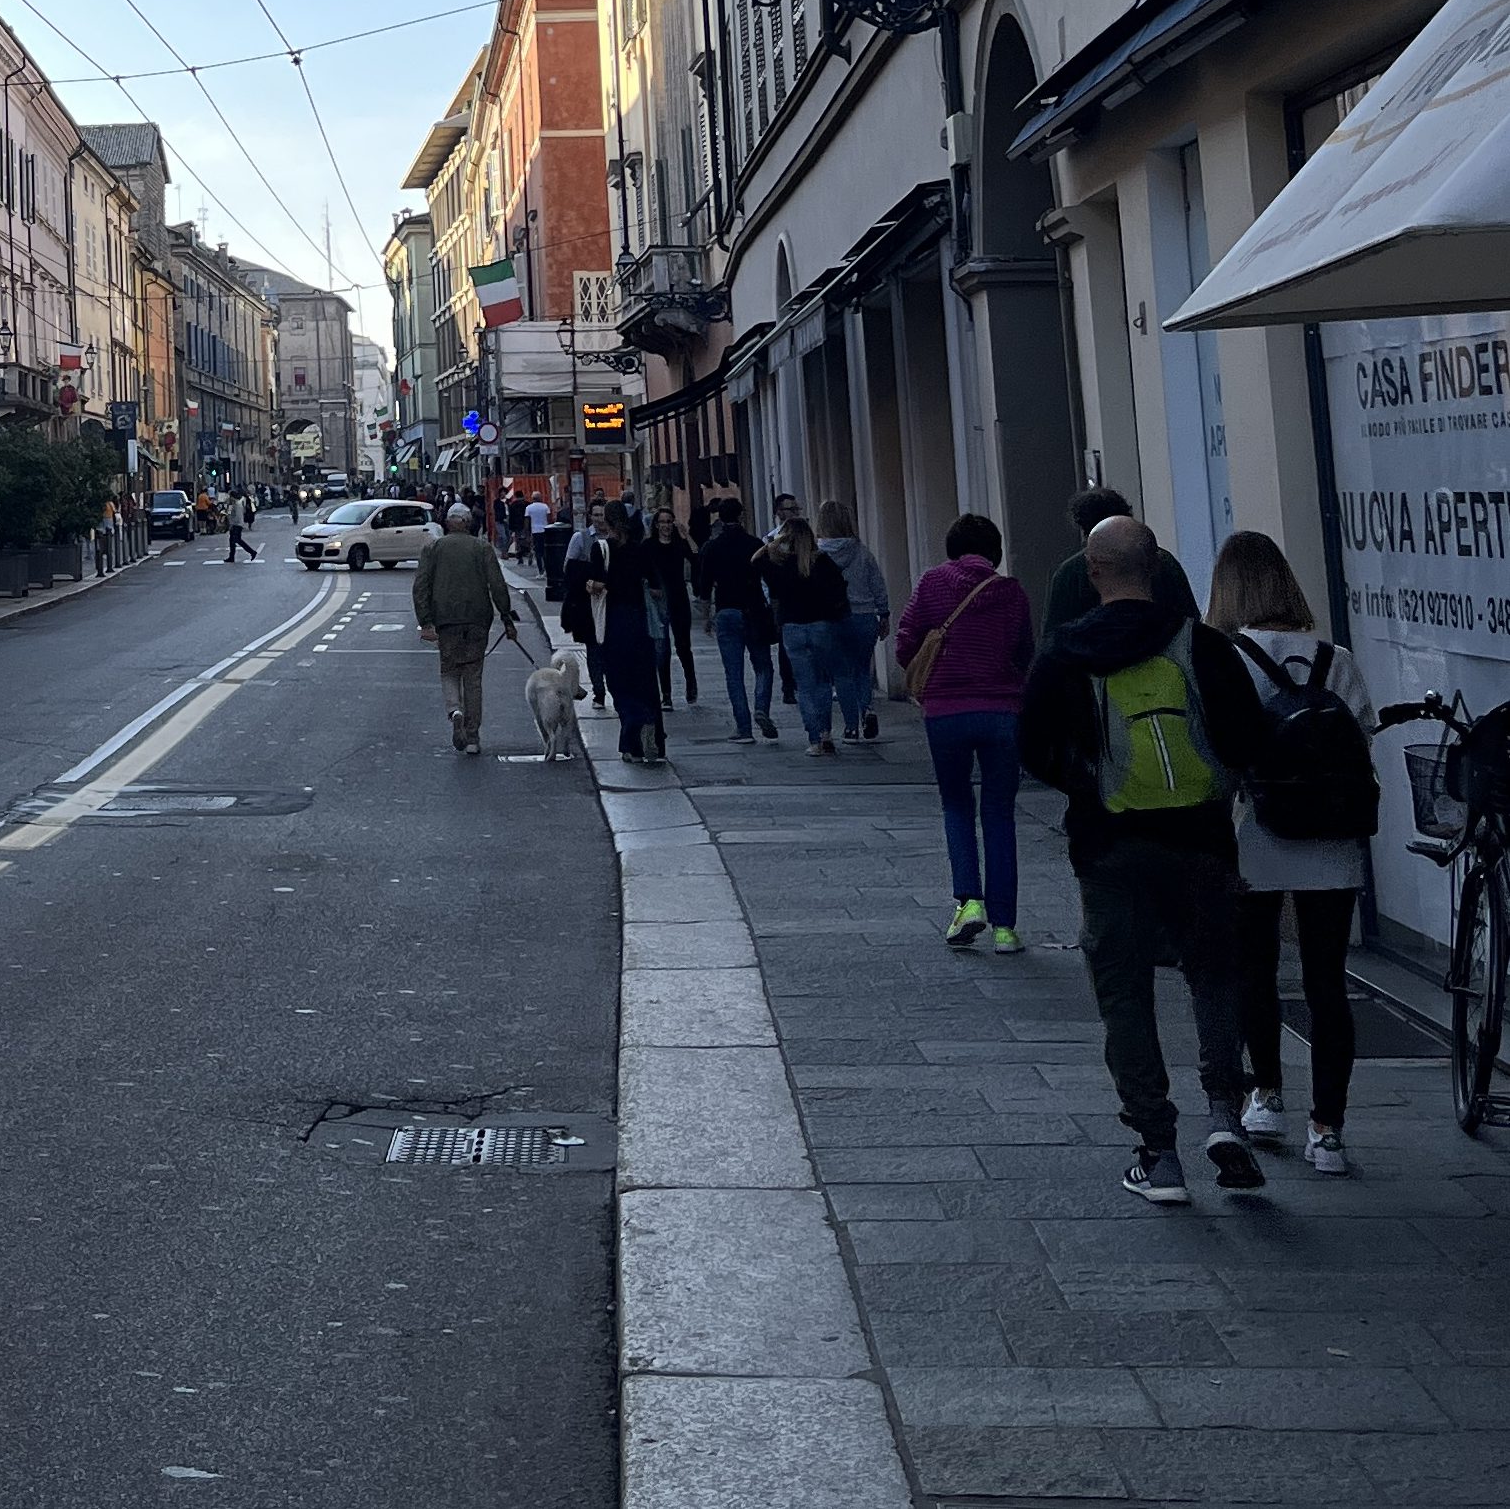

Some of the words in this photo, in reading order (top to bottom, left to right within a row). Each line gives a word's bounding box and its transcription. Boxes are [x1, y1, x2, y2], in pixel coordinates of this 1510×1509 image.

[1356, 356, 1414, 410] CASA
[1418, 339, 1510, 403] FINDER
[1368, 421, 1390, 438] MODO
[1438, 415, 1445, 433] DI
[1447, 411, 1488, 431] TROVARE
[1339, 491, 1416, 554] NUOVA
[1424, 491, 1510, 559] APERT
[1398, 588, 1474, 631] 0521927910
